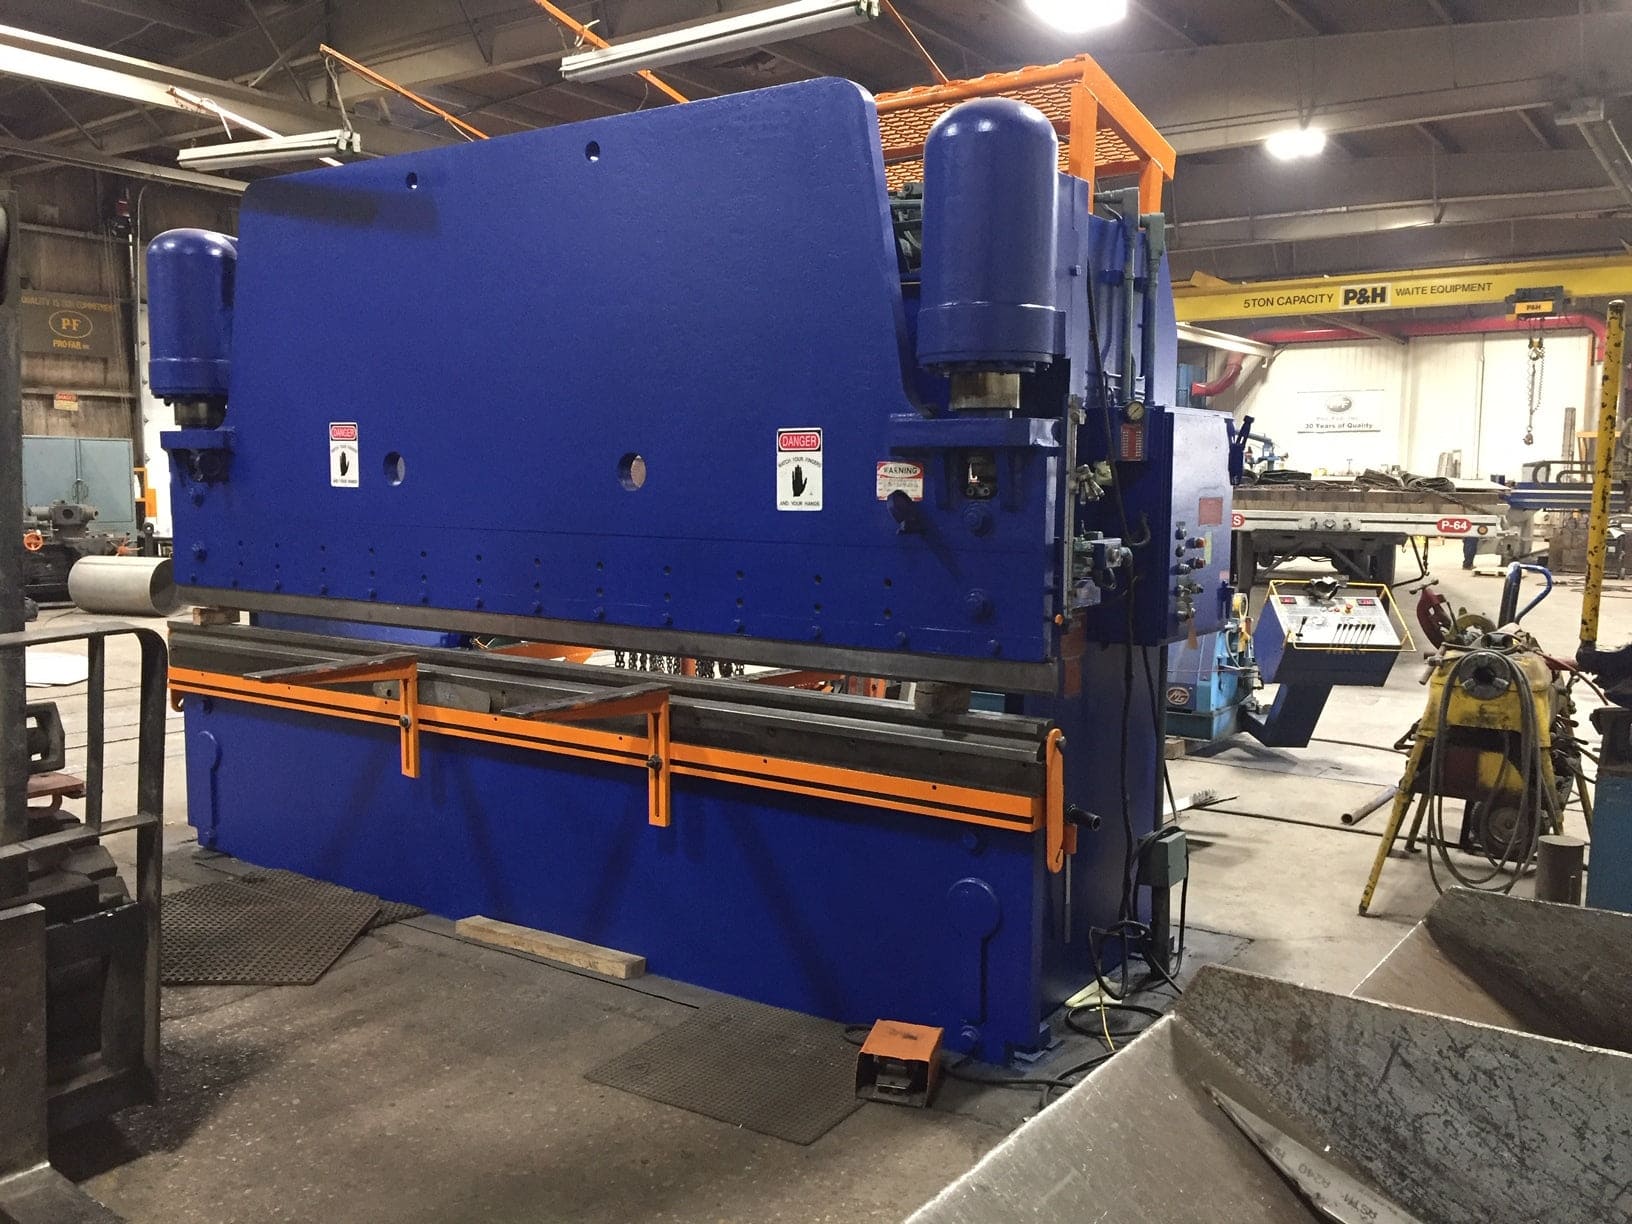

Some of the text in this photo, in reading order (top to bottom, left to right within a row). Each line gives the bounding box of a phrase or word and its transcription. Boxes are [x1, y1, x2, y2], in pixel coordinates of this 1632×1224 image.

[1276, 293, 1335, 306] CAPACITY
[1343, 286, 1387, 305] P&H
[1395, 286, 1427, 297] WAITE
[1430, 282, 1493, 295] EQUIPMENT
[782, 435, 817, 448] DANGER
[1441, 520, 1468, 530] P-64
